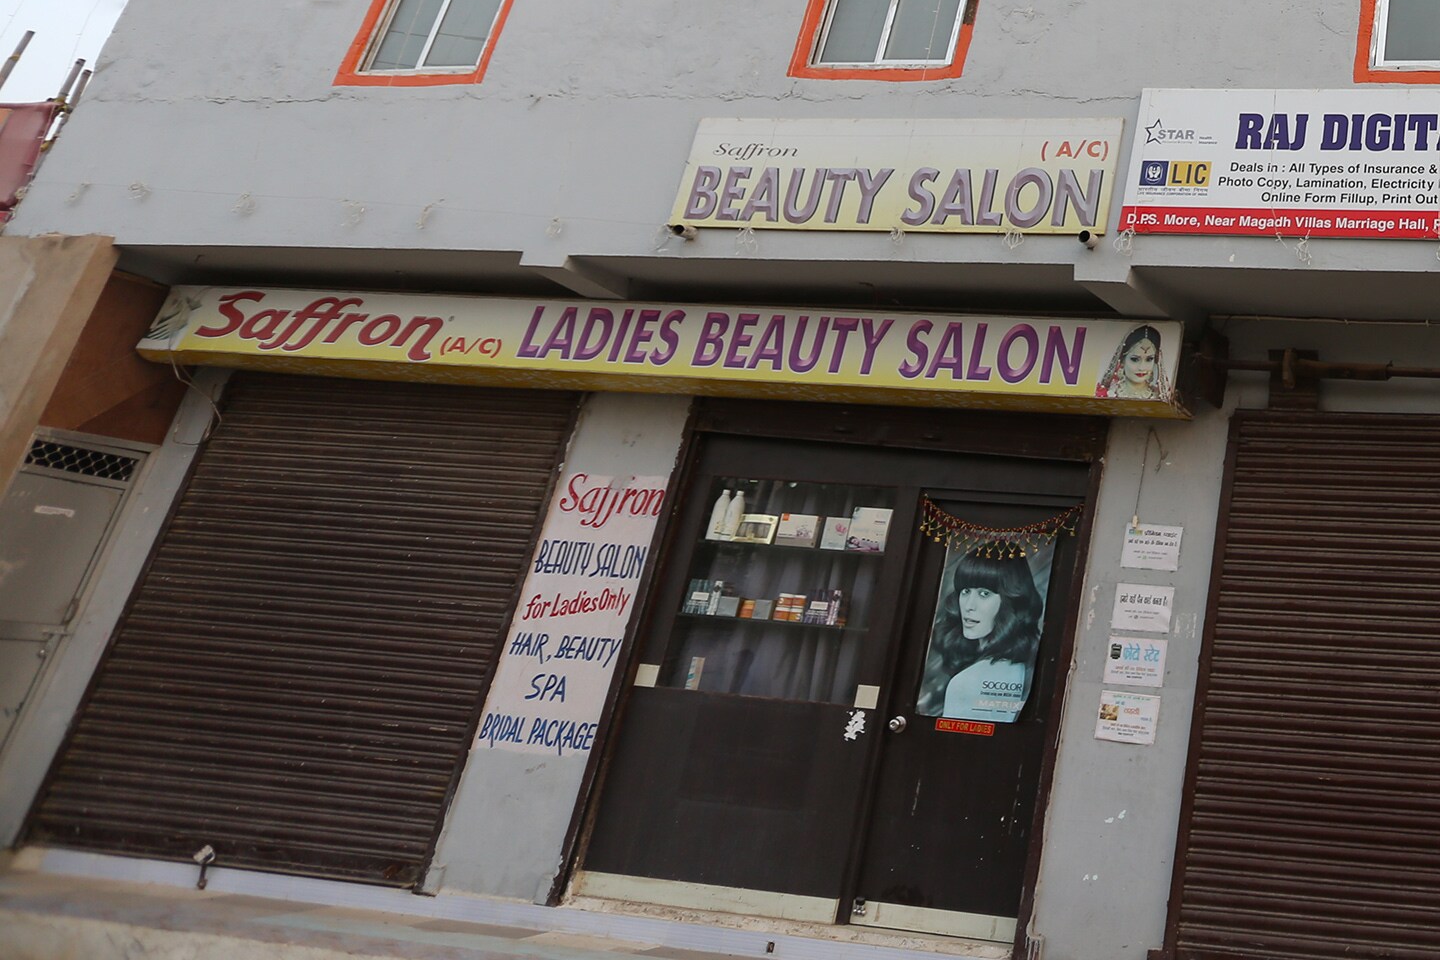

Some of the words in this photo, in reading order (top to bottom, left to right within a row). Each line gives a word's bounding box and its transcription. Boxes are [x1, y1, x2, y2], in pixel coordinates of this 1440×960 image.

[1158, 129, 1195, 140] STAR
[1235, 112, 1309, 151] RAJ
[713, 142, 799, 161] Saffron
[1171, 163, 1207, 185] LIC
[1230, 162, 1264, 173] Deals
[1267, 162, 1278, 173] in
[1289, 162, 1305, 173] All
[1309, 163, 1344, 176] Types
[1347, 162, 1361, 174] of
[1364, 163, 1426, 174] Insurance
[1429, 164, 1438, 174] &
[1218, 176, 1253, 187] Photo
[1256, 177, 1292, 190] Copy,
[1296, 178, 1367, 190] Lamination,
[1371, 178, 1435, 191] Electricity
[683, 165, 895, 224] BEAUTY
[900, 167, 1105, 228] SALON
[1261, 192, 1300, 203] Online
[1304, 193, 1336, 204] Form
[1340, 193, 1377, 206] Fillup,
[1382, 193, 1412, 204] Print
[1415, 194, 1438, 205] Out
[1164, 214, 1201, 228] More,
[1205, 215, 1235, 227] Near
[1239, 215, 1291, 231] Magadh
[1295, 217, 1331, 229] Villas
[1335, 218, 1395, 232] Marriage
[1399, 218, 1429, 231] Hall,
[194, 290, 446, 362] Saffron
[440, 336, 502, 359] (A/C)
[516, 305, 686, 367] LADIES
[691, 312, 895, 376] BEAUTY
[897, 319, 1088, 385] SALON
[560, 473, 666, 528] Saffron
[534, 539, 596, 577] BEAUTY
[589, 544, 648, 579] SALON
[522, 593, 551, 620] for
[550, 591, 598, 617] Ladies
[600, 587, 631, 617] Only
[509, 632, 552, 664] HAIR,
[554, 635, 622, 668] BEAUTY
[525, 673, 567, 703] SPA
[982, 680, 1023, 691] SOCOLOR
[978, 700, 1020, 710] MATRIX
[479, 713, 526, 748] BRIDAL
[526, 717, 598, 756] PACKAGE
[956, 721, 969, 732] FOR
[969, 722, 992, 735] LADIES
